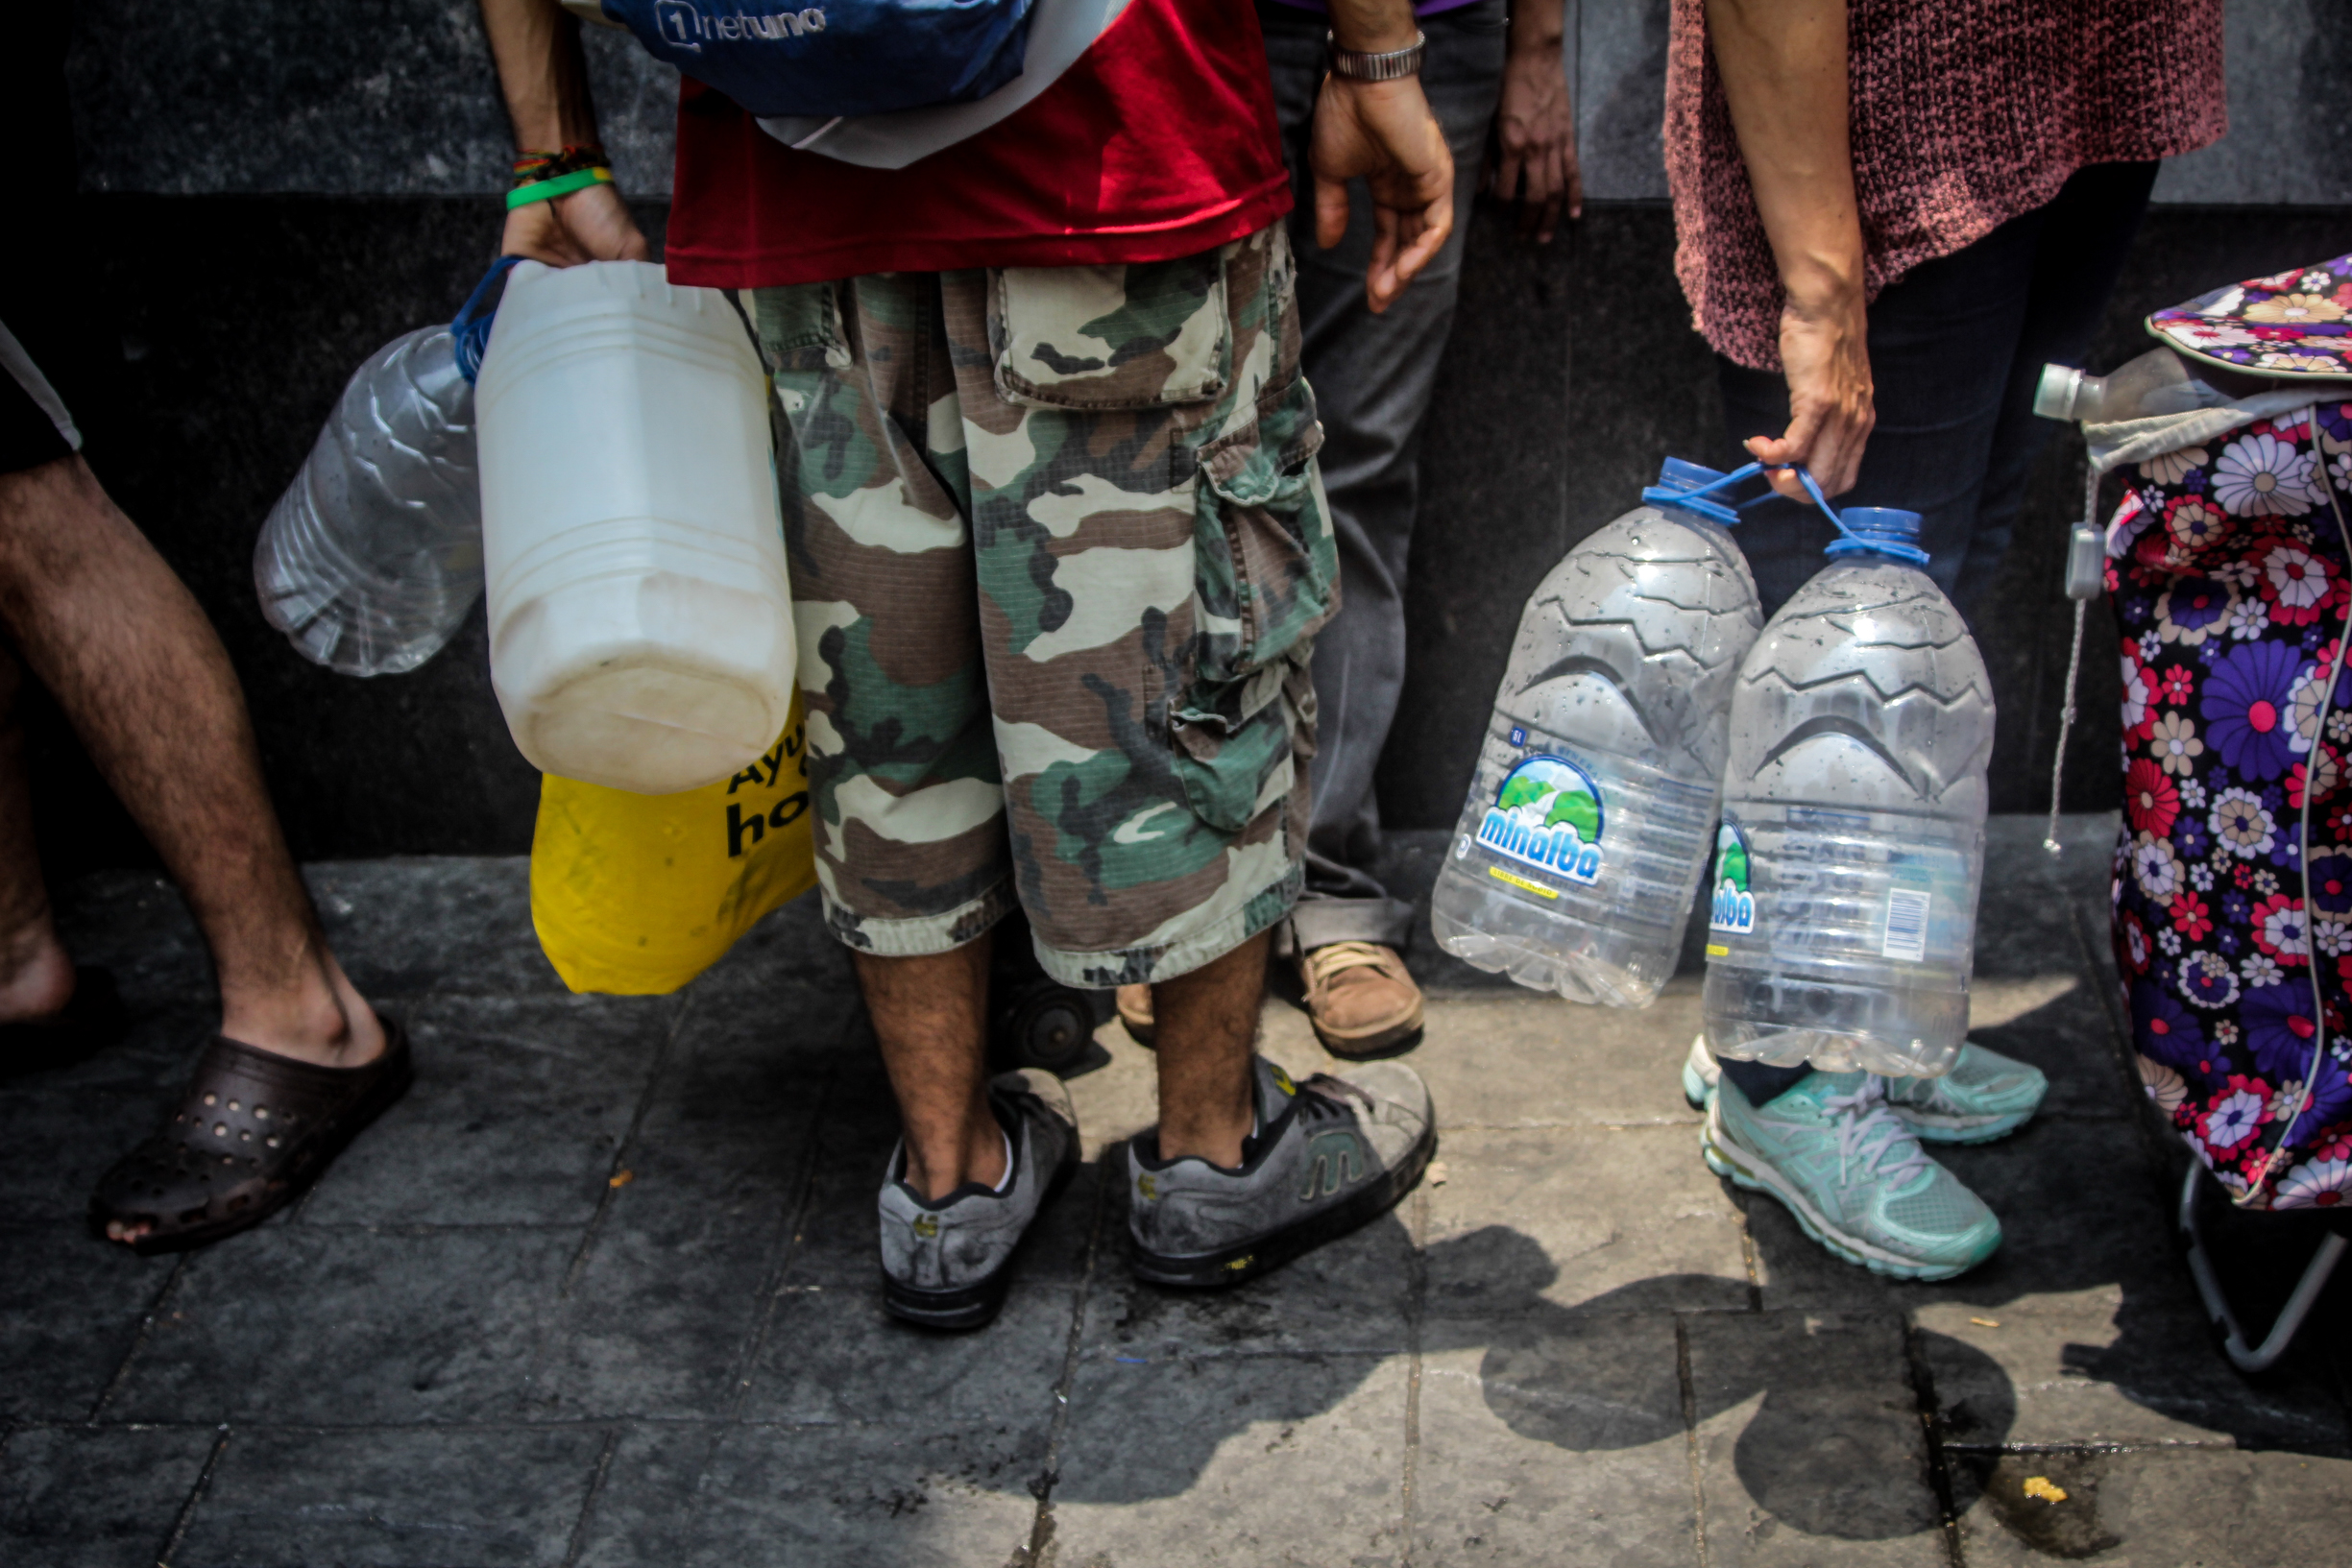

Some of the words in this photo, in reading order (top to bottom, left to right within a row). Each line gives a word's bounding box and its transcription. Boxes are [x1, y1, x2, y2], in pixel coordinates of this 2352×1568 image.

[703, 7, 826, 40] netuno
[726, 723, 808, 795] Ayu
[1480, 811, 1600, 878] minalba
[1493, 869, 1513, 881] LIBRE
[1515, 878, 1525, 886] DE
[1711, 885, 1752, 927] alba
